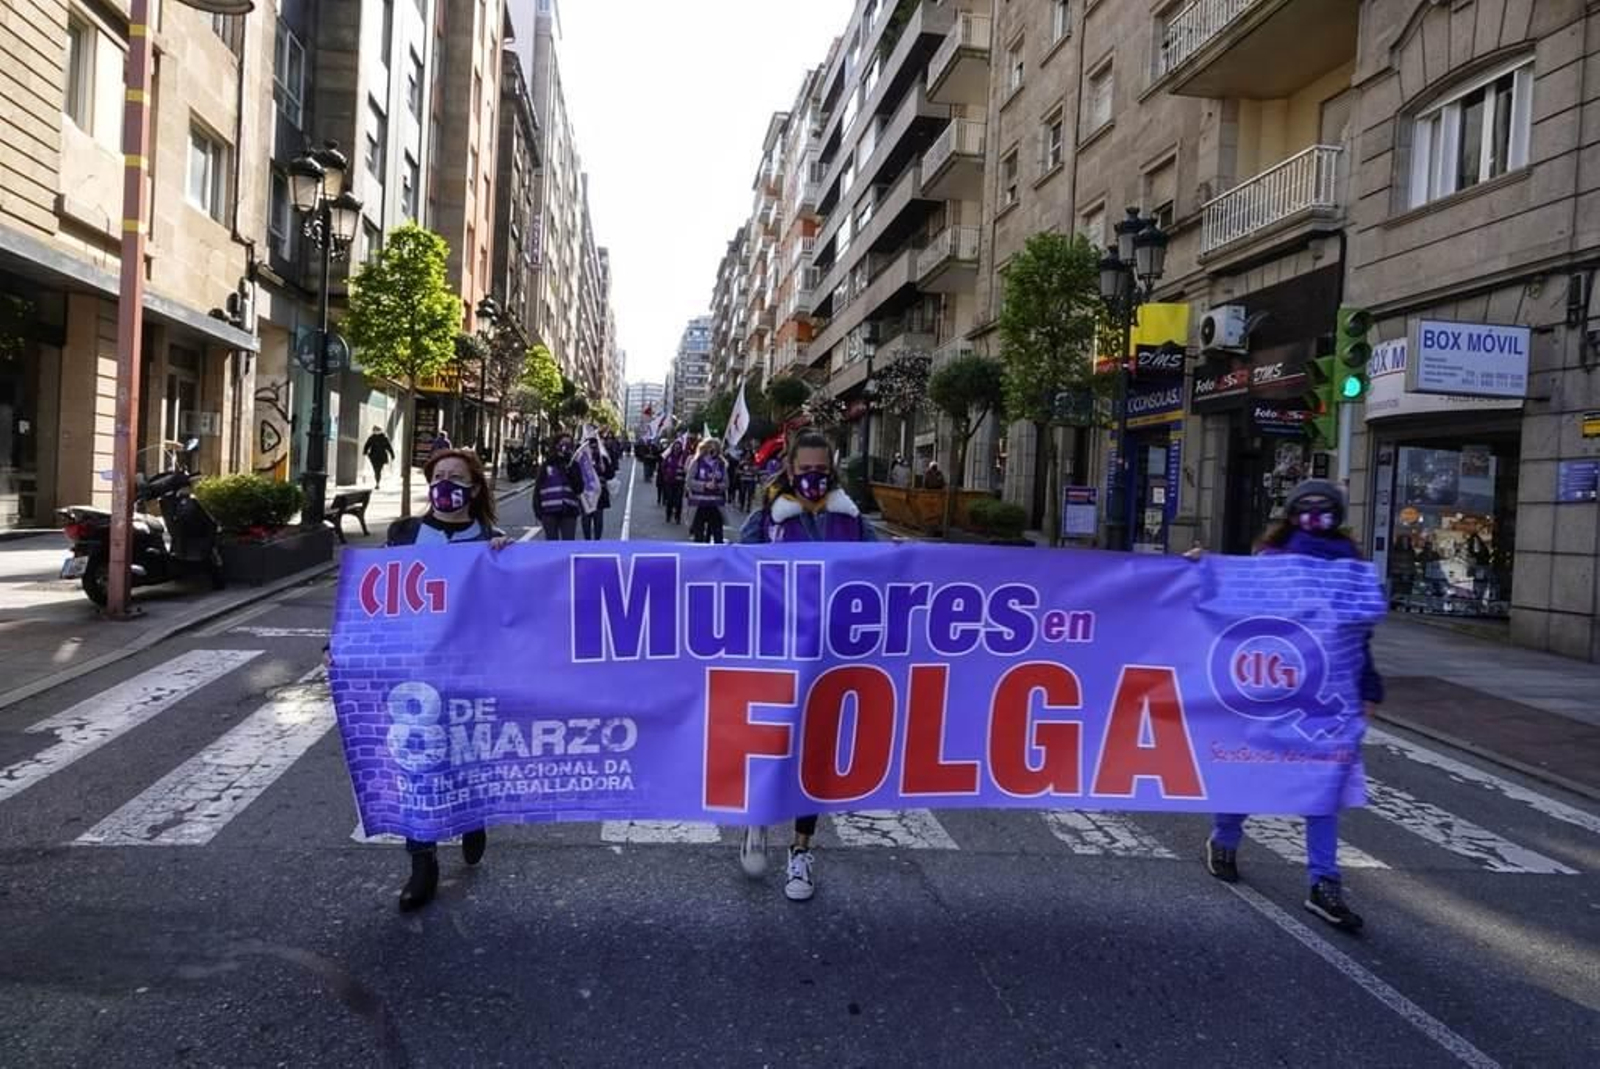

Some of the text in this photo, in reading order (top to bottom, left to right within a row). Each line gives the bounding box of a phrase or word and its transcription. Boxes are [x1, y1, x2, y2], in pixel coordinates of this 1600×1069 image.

[1423, 328, 1524, 356] BOX MÓVIL
[359, 561, 447, 617] CIG
[570, 553, 1096, 664] Mulleres en
[1234, 650, 1299, 689] CIG
[386, 681, 449, 772] 8
[449, 697, 498, 722] DE
[449, 717, 638, 766] MARZO
[702, 661, 1208, 814] FOLGA
[475, 776, 634, 799] TRABALLADORA
[604, 760, 632, 775] DA
